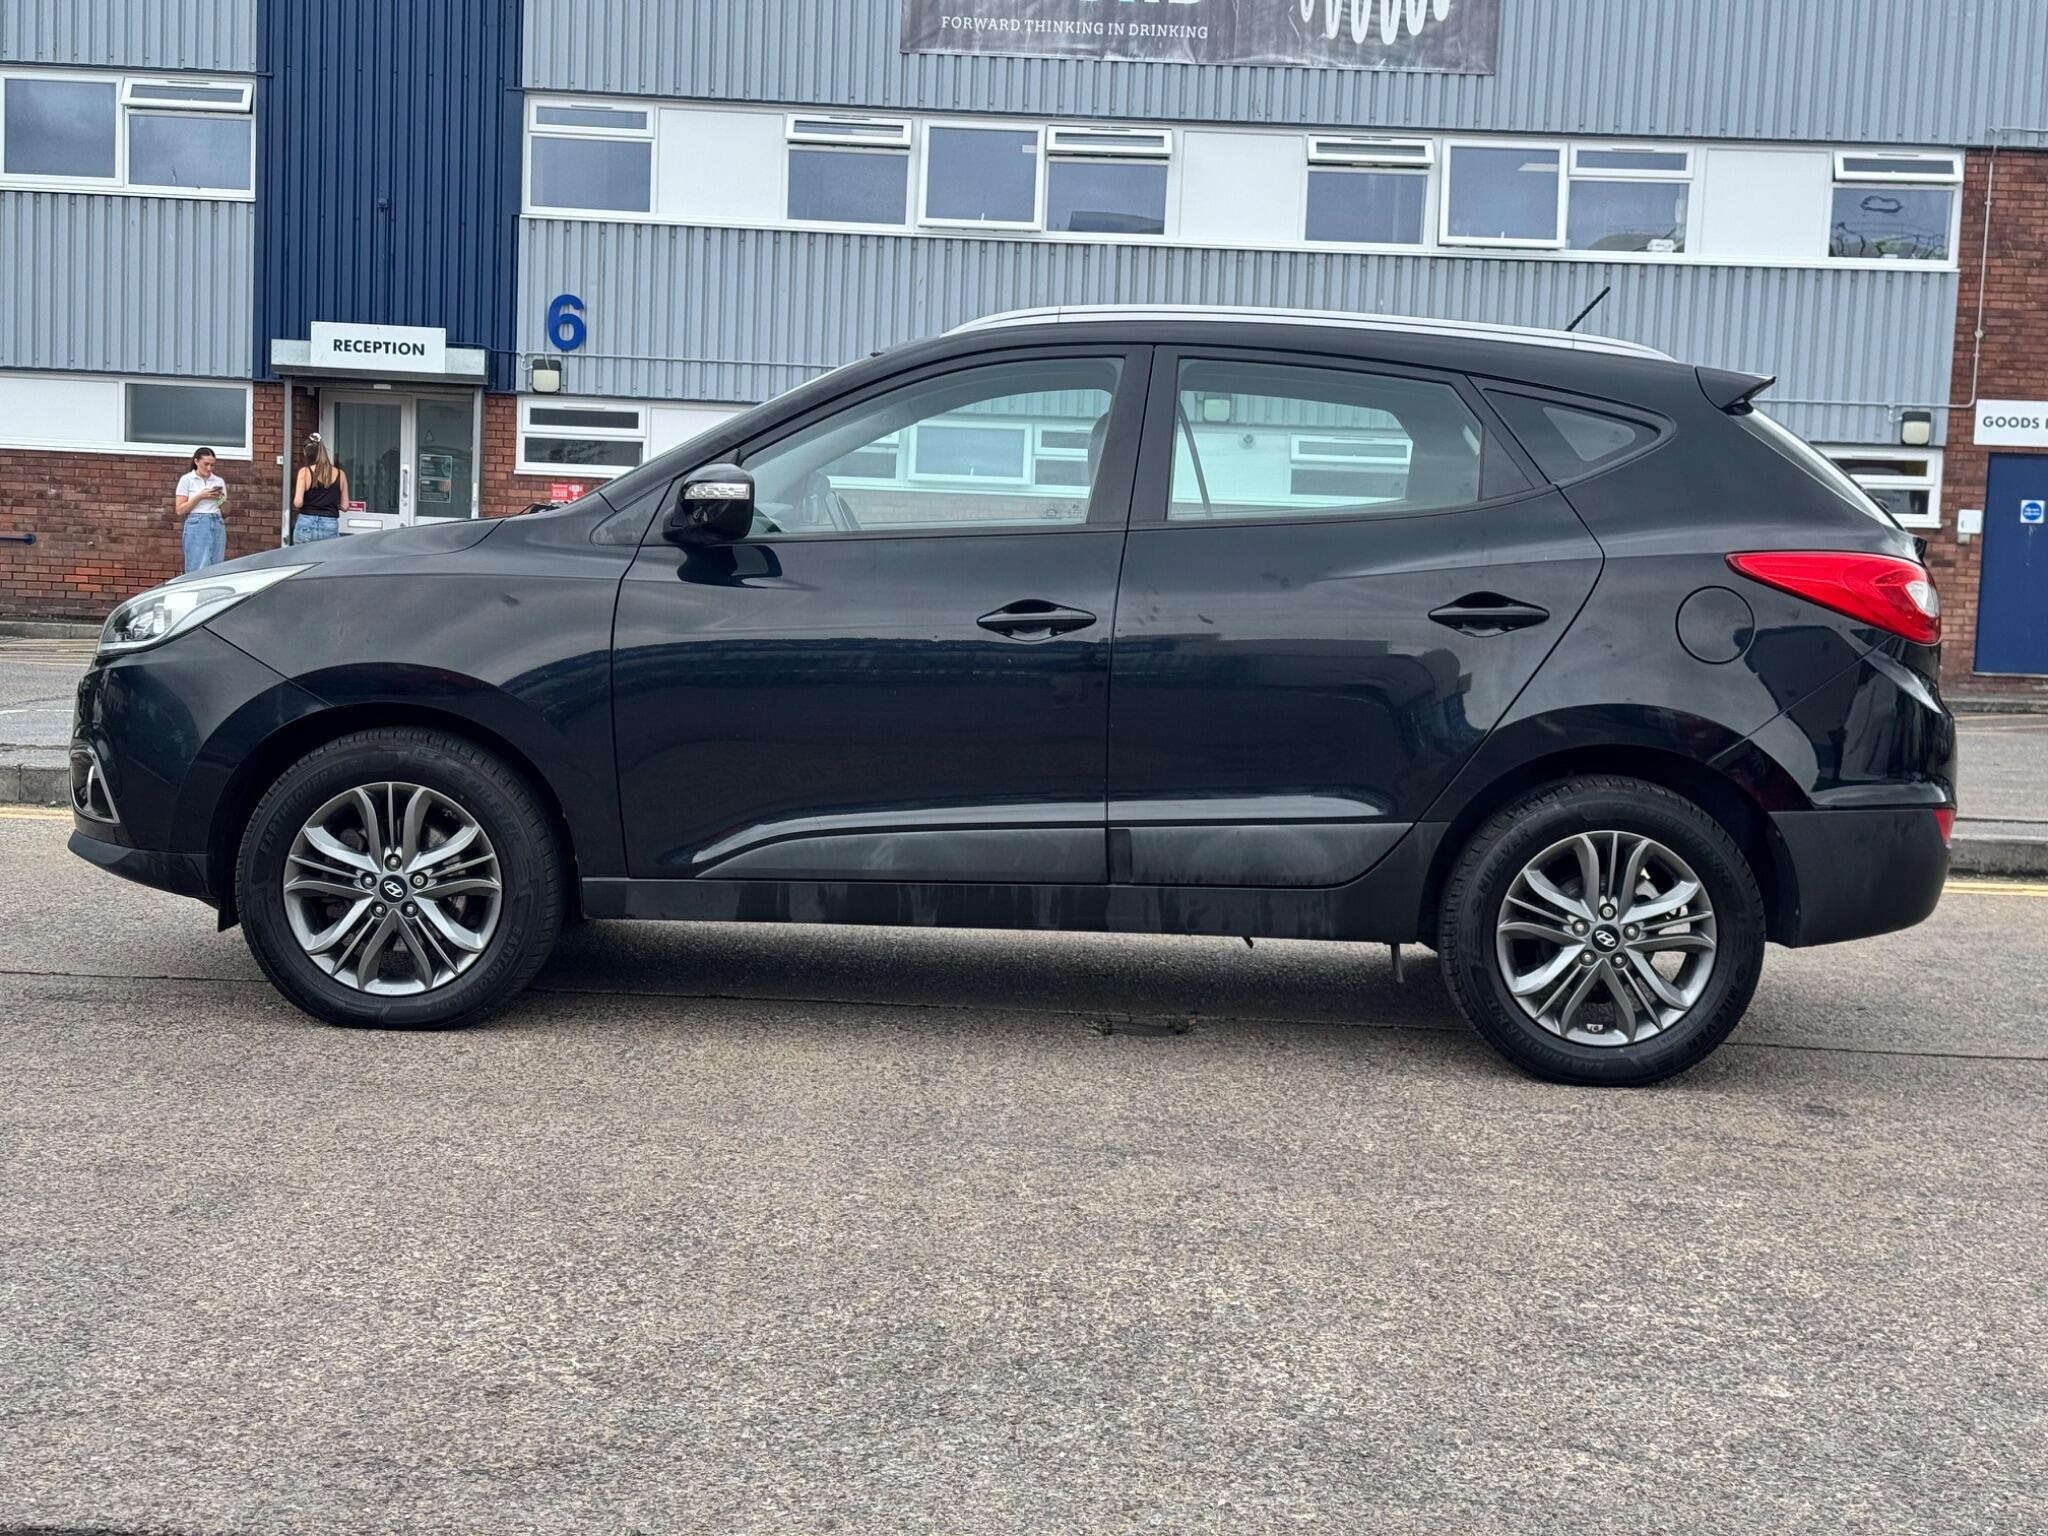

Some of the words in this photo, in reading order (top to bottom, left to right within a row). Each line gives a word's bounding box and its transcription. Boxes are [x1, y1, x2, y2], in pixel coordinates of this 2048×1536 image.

[941, 16, 1021, 31] FORWARD
[1024, 19, 1104, 35] THINKING
[1108, 23, 1125, 35] IN
[1129, 23, 1208, 39] DRINKING
[547, 294, 587, 351] 6
[333, 338, 425, 356] RECEPTION
[1983, 416, 2040, 429] GOODS
